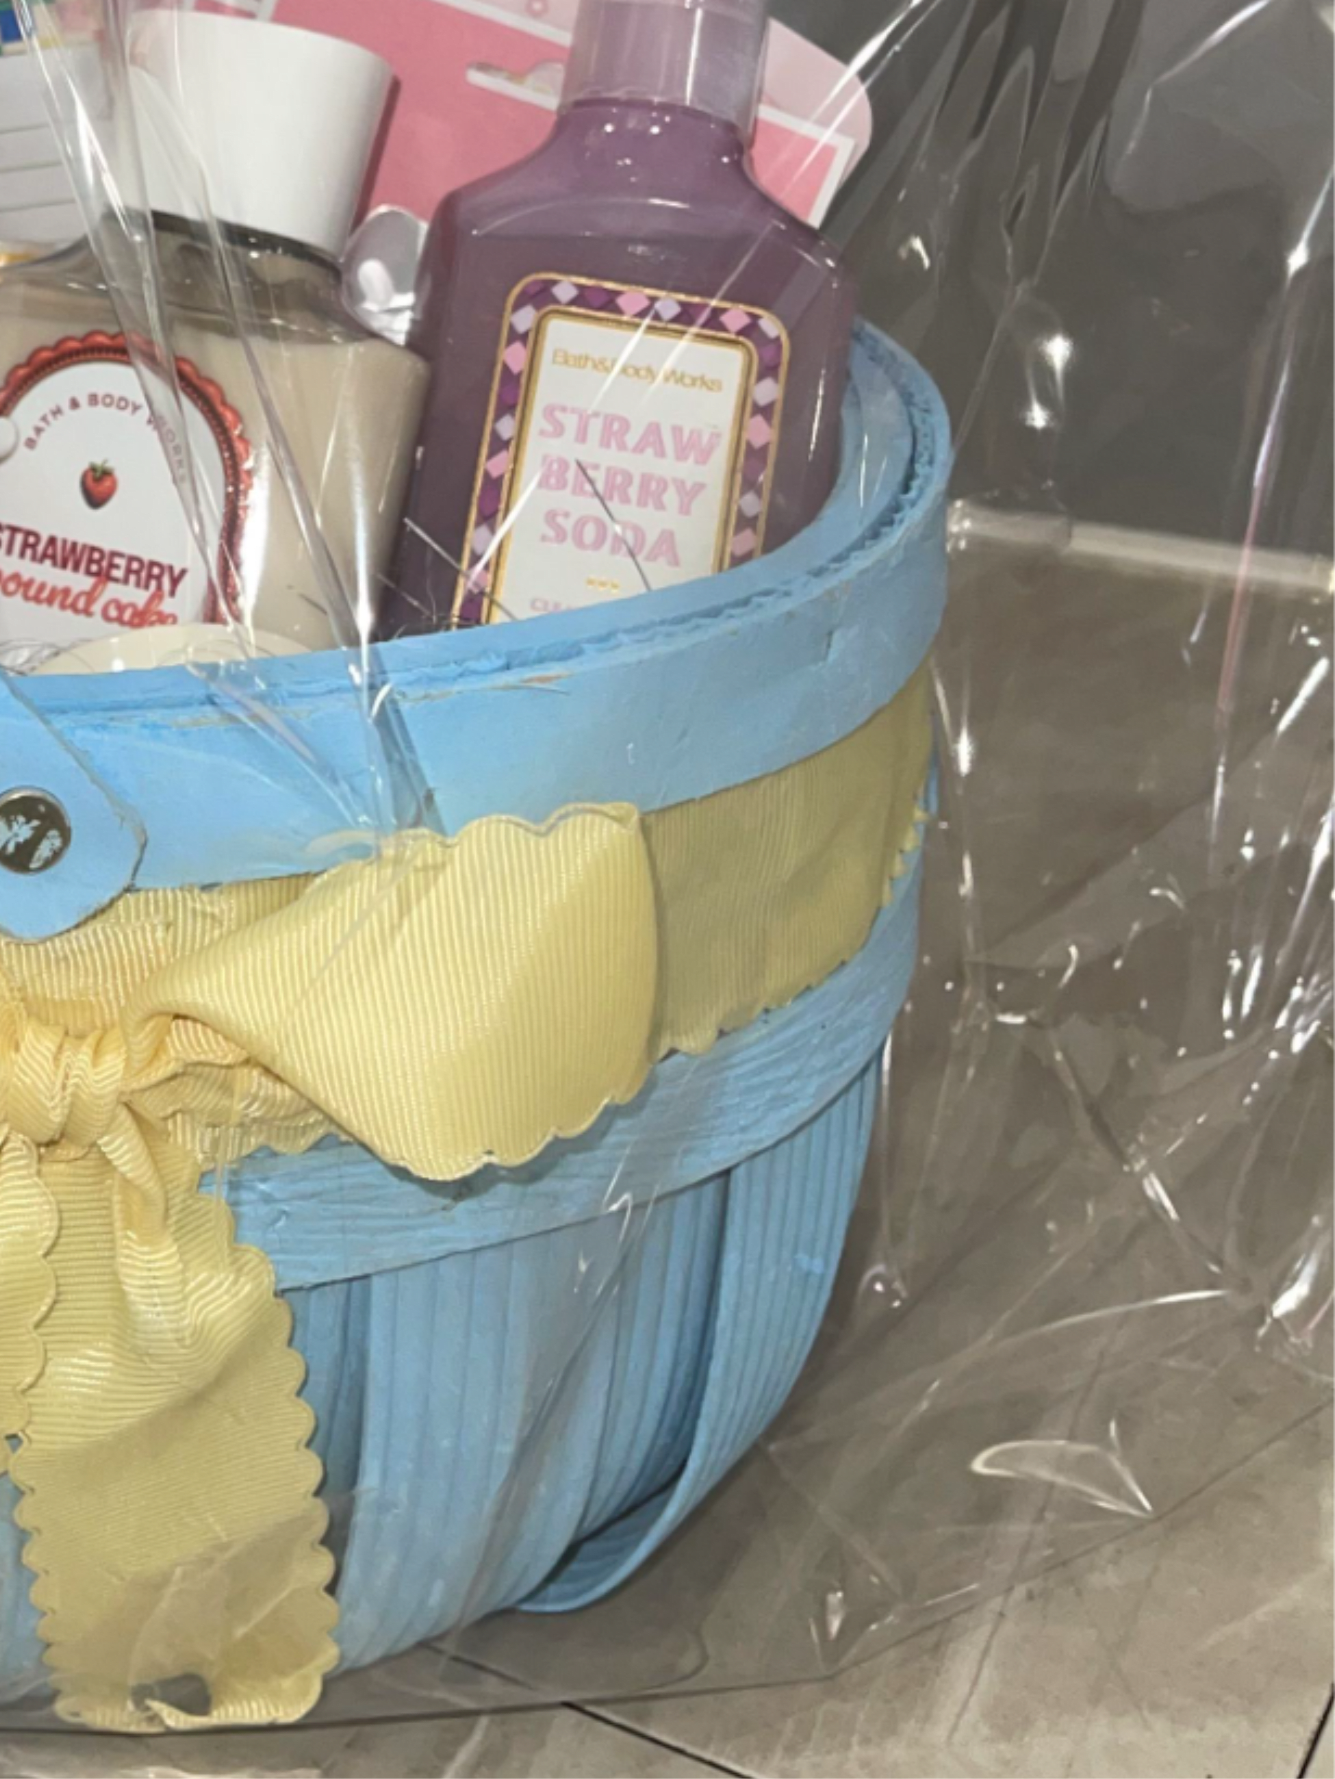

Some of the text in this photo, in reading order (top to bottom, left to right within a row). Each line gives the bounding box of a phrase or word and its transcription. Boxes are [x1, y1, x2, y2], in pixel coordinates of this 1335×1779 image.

[663, 369, 724, 393] Works
[23, 405, 64, 451] BATH
[68, 395, 81, 411] &
[87, 392, 143, 415] BODY
[538, 402, 723, 466] STRAW
[537, 452, 708, 517] BERRY
[539, 507, 682, 568] SODA
[101, 588, 179, 630] cake
